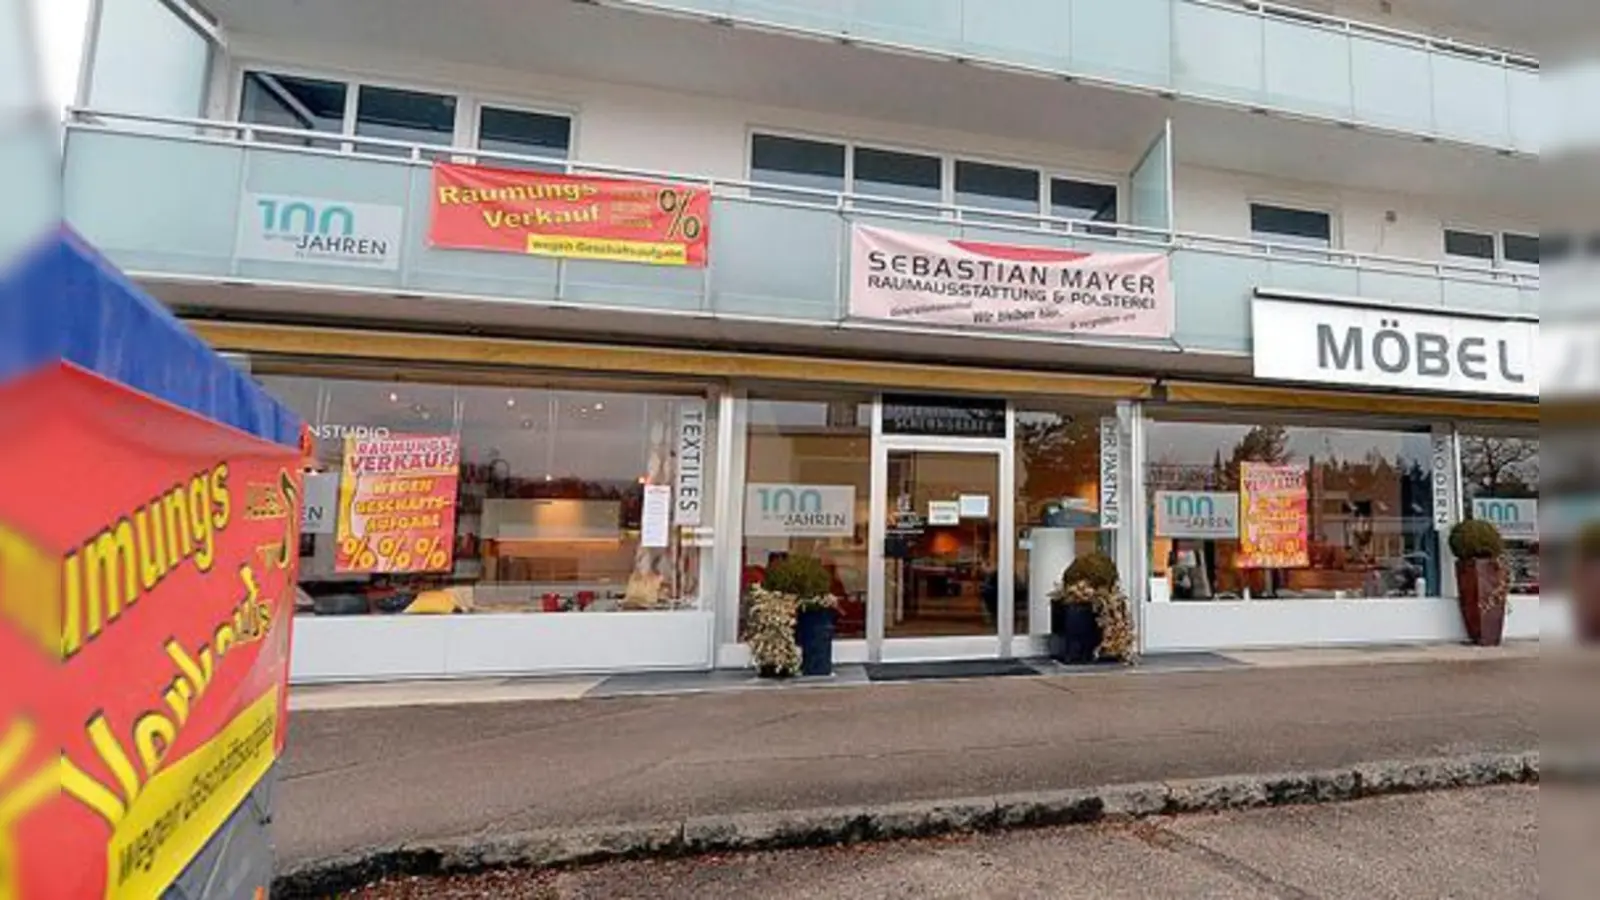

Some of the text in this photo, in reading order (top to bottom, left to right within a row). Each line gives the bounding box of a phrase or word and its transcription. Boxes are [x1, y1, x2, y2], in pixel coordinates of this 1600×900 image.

[257, 200, 354, 236] 100
[483, 204, 602, 230] Verkauf
[296, 234, 387, 256] JAHREN
[868, 250, 1156, 295] SEBASTIAN MAYER
[868, 274, 1156, 311] RAUMAUSSTATTUNG & POLSTEREI
[1316, 319, 1524, 383] MÖBEL
[679, 412, 703, 512] TEXTILES
[1103, 452, 1118, 525] PARTNER
[1433, 440, 1448, 524] MODERN
[757, 488, 822, 513] 100
[1164, 495, 1214, 516] 100
[783, 512, 847, 526] JAHREN
